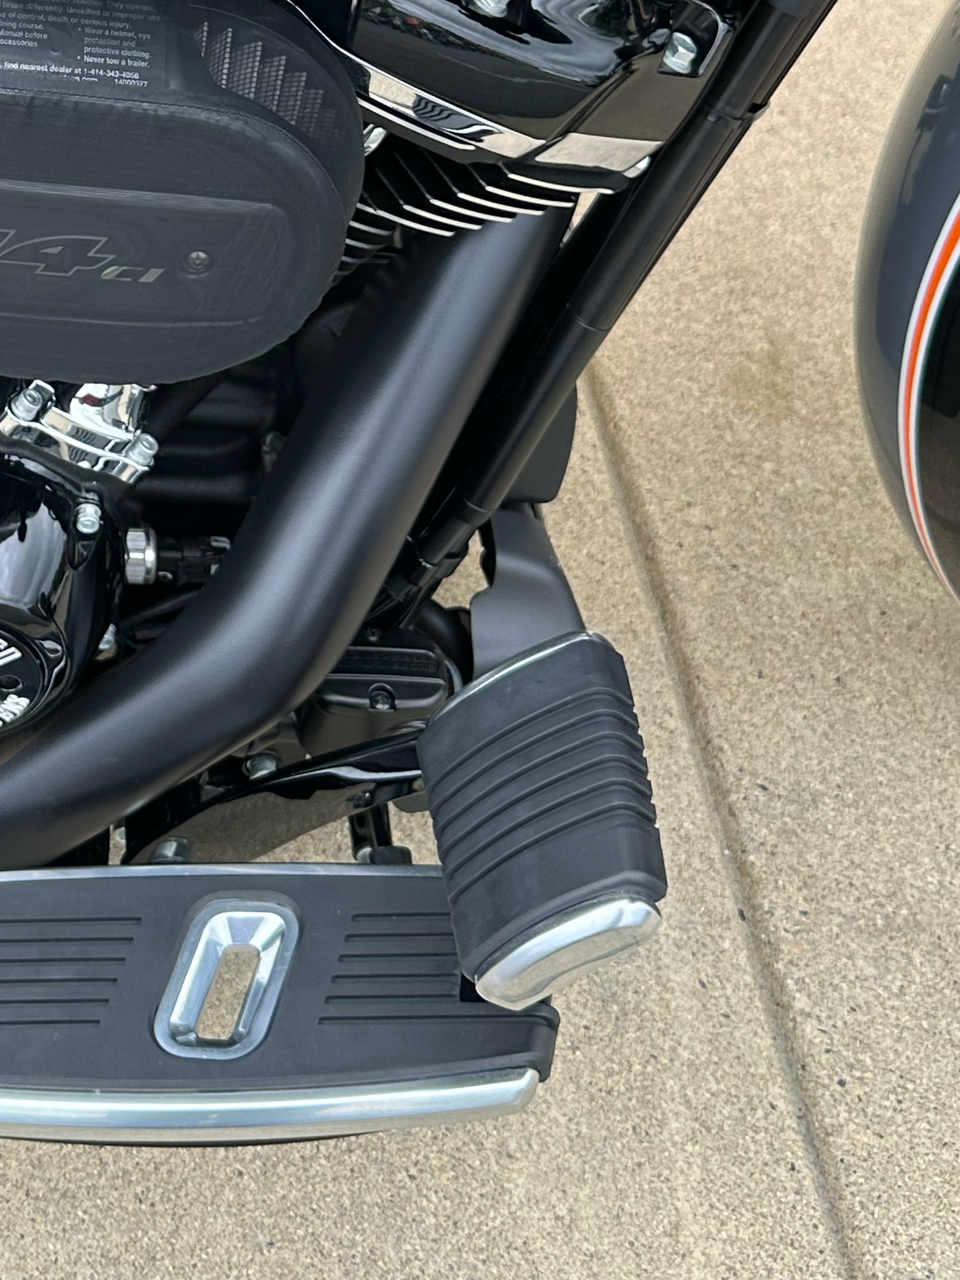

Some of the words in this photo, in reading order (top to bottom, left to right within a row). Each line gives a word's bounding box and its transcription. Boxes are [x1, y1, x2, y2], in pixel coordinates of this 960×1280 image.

[8, 10, 16, 18] of
[17, 12, 45, 22] control,
[48, 14, 69, 23] death
[80, 18, 108, 26] serious
[109, 20, 132, 30] injury.
[18, 22, 45, 30] course.
[25, 30, 48, 40] before
[84, 27, 102, 35] Wear
[110, 29, 137, 39] helmet,
[84, 36, 120, 46] protection
[122, 39, 136, 47] and
[83, 46, 119, 55] protective
[121, 49, 152, 60] clothing.
[83, 54, 105, 64] Never
[106, 57, 119, 65] tow
[127, 58, 150, 68] trailer.
[4, 61, 18, 69] find
[20, 62, 48, 72] nearest
[49, 64, 72, 74] dealer
